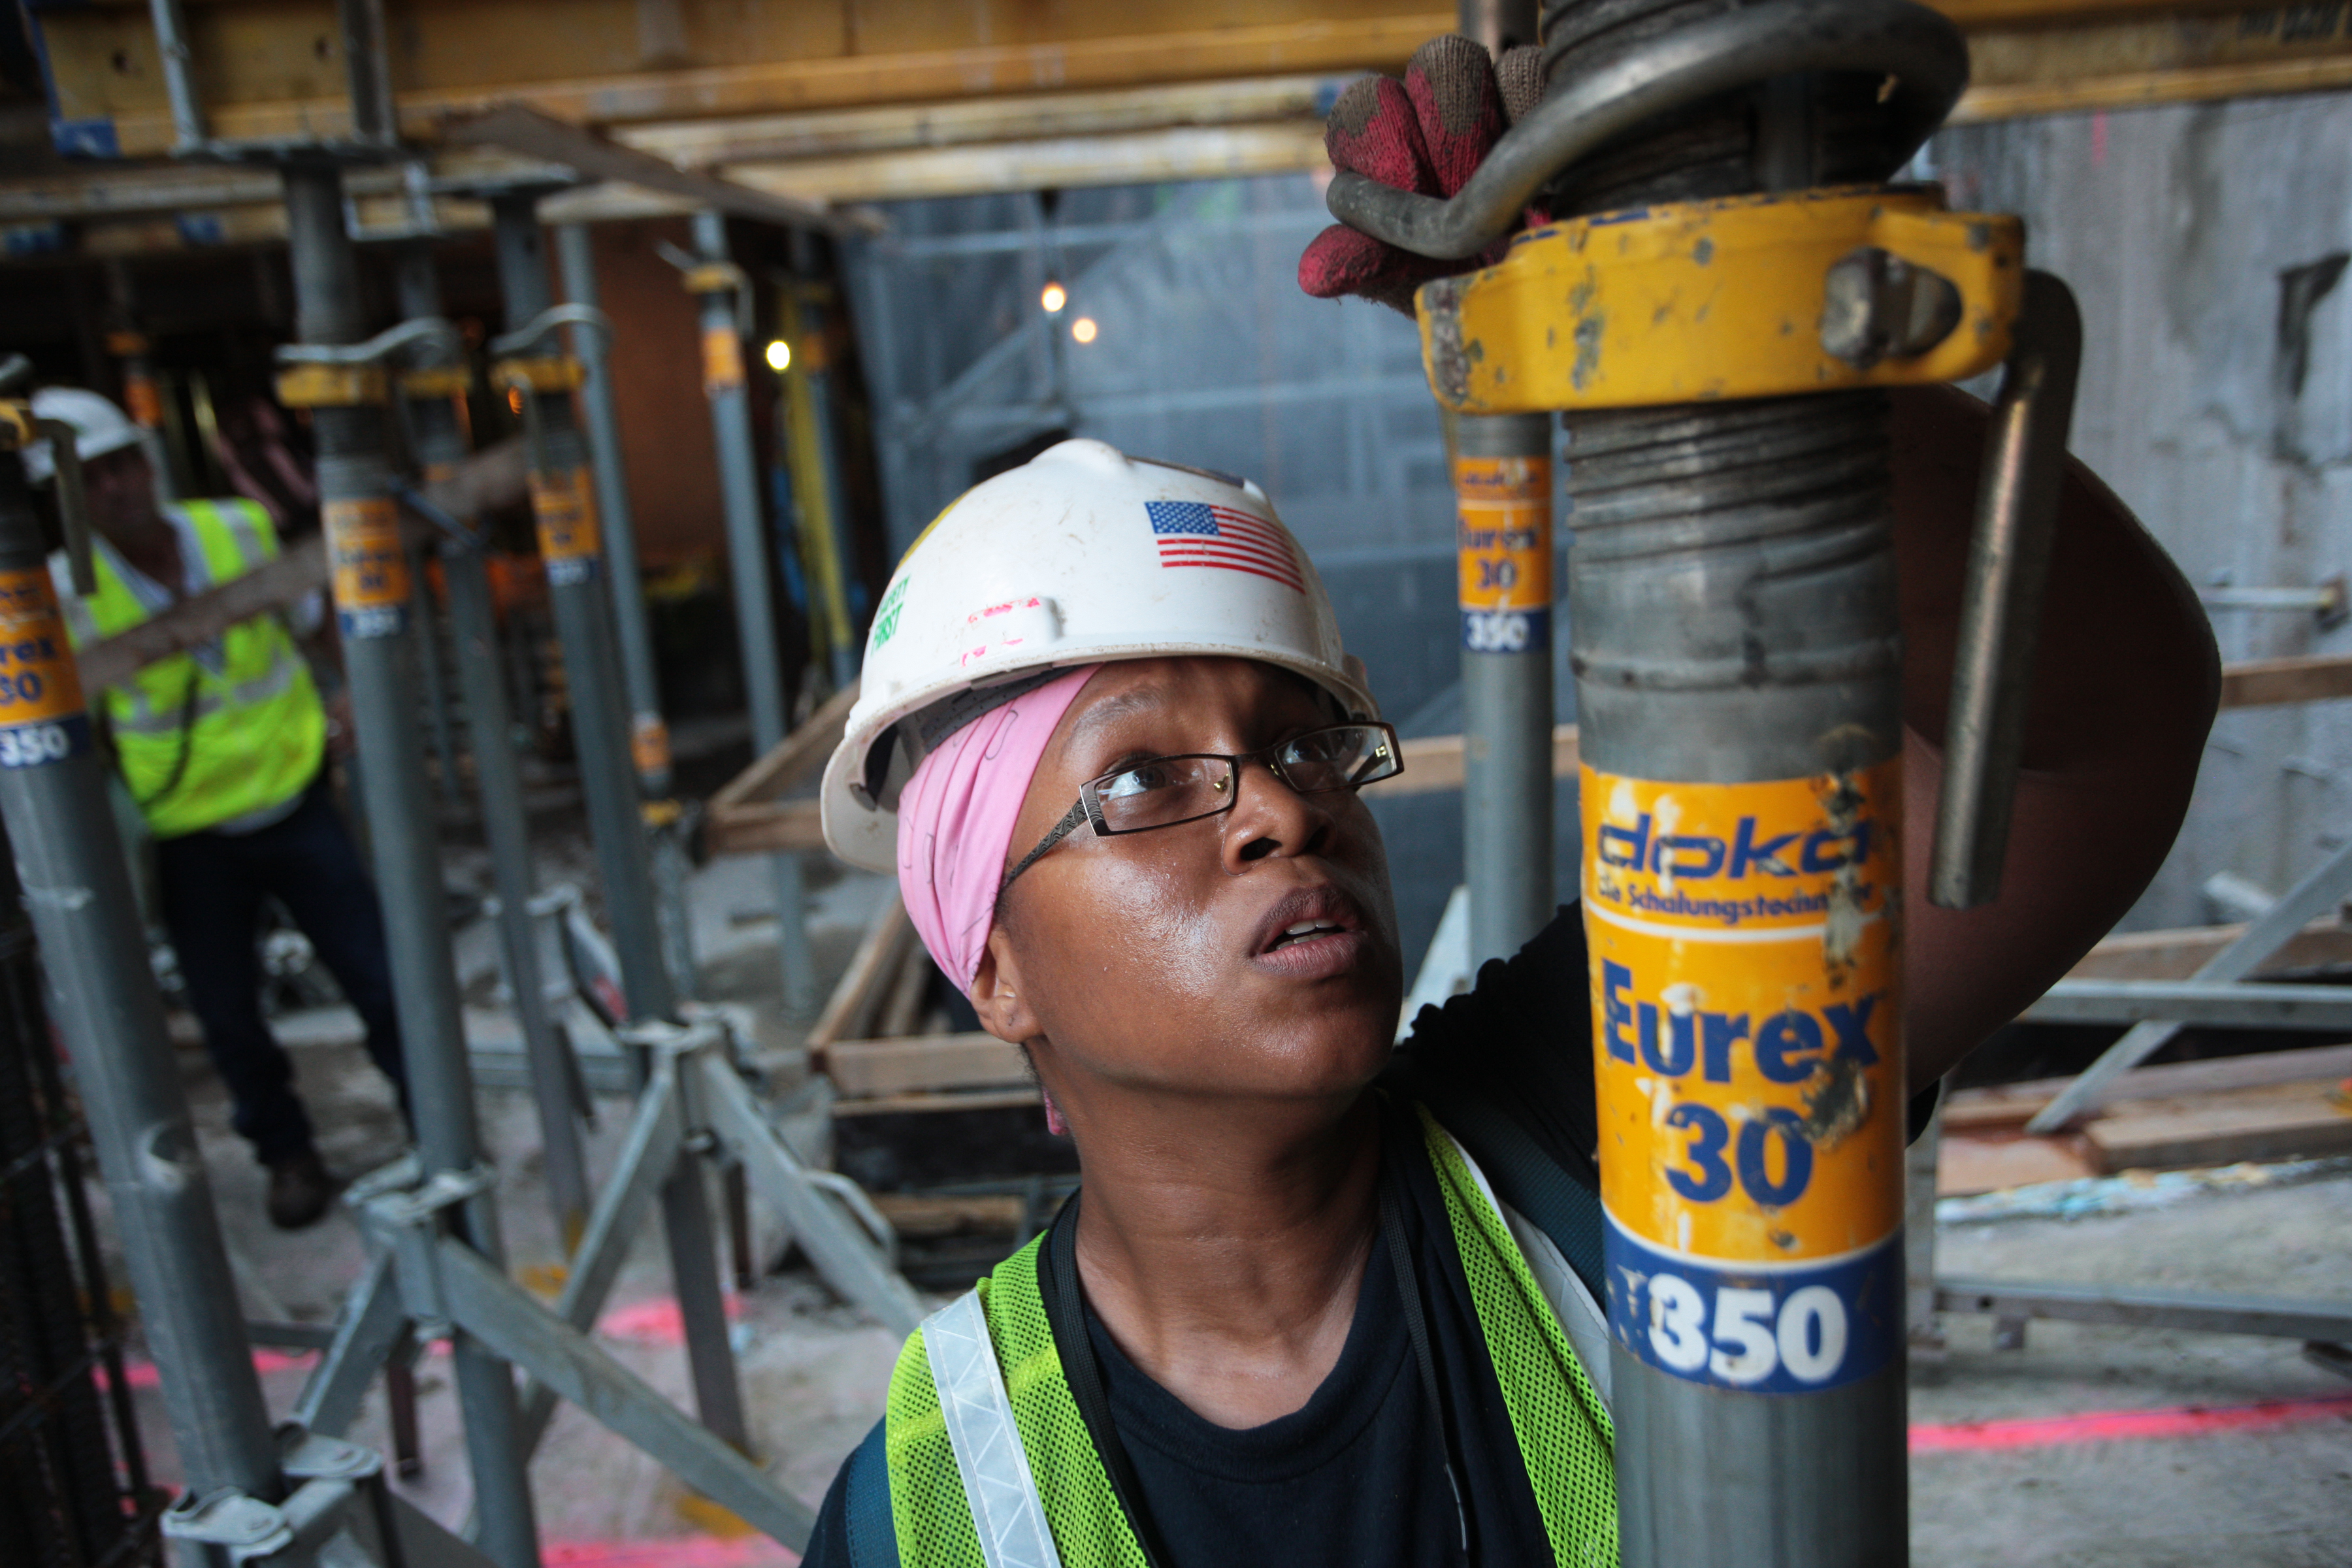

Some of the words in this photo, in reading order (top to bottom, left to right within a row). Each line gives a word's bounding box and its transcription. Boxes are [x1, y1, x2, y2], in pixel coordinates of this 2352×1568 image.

[870, 601, 903, 657] FIRST
[1597, 813, 1872, 879] doka
[1602, 957, 1880, 1084] Eurex
[1664, 1101, 1813, 1207] 30
[1648, 1273, 1848, 1385] 350
